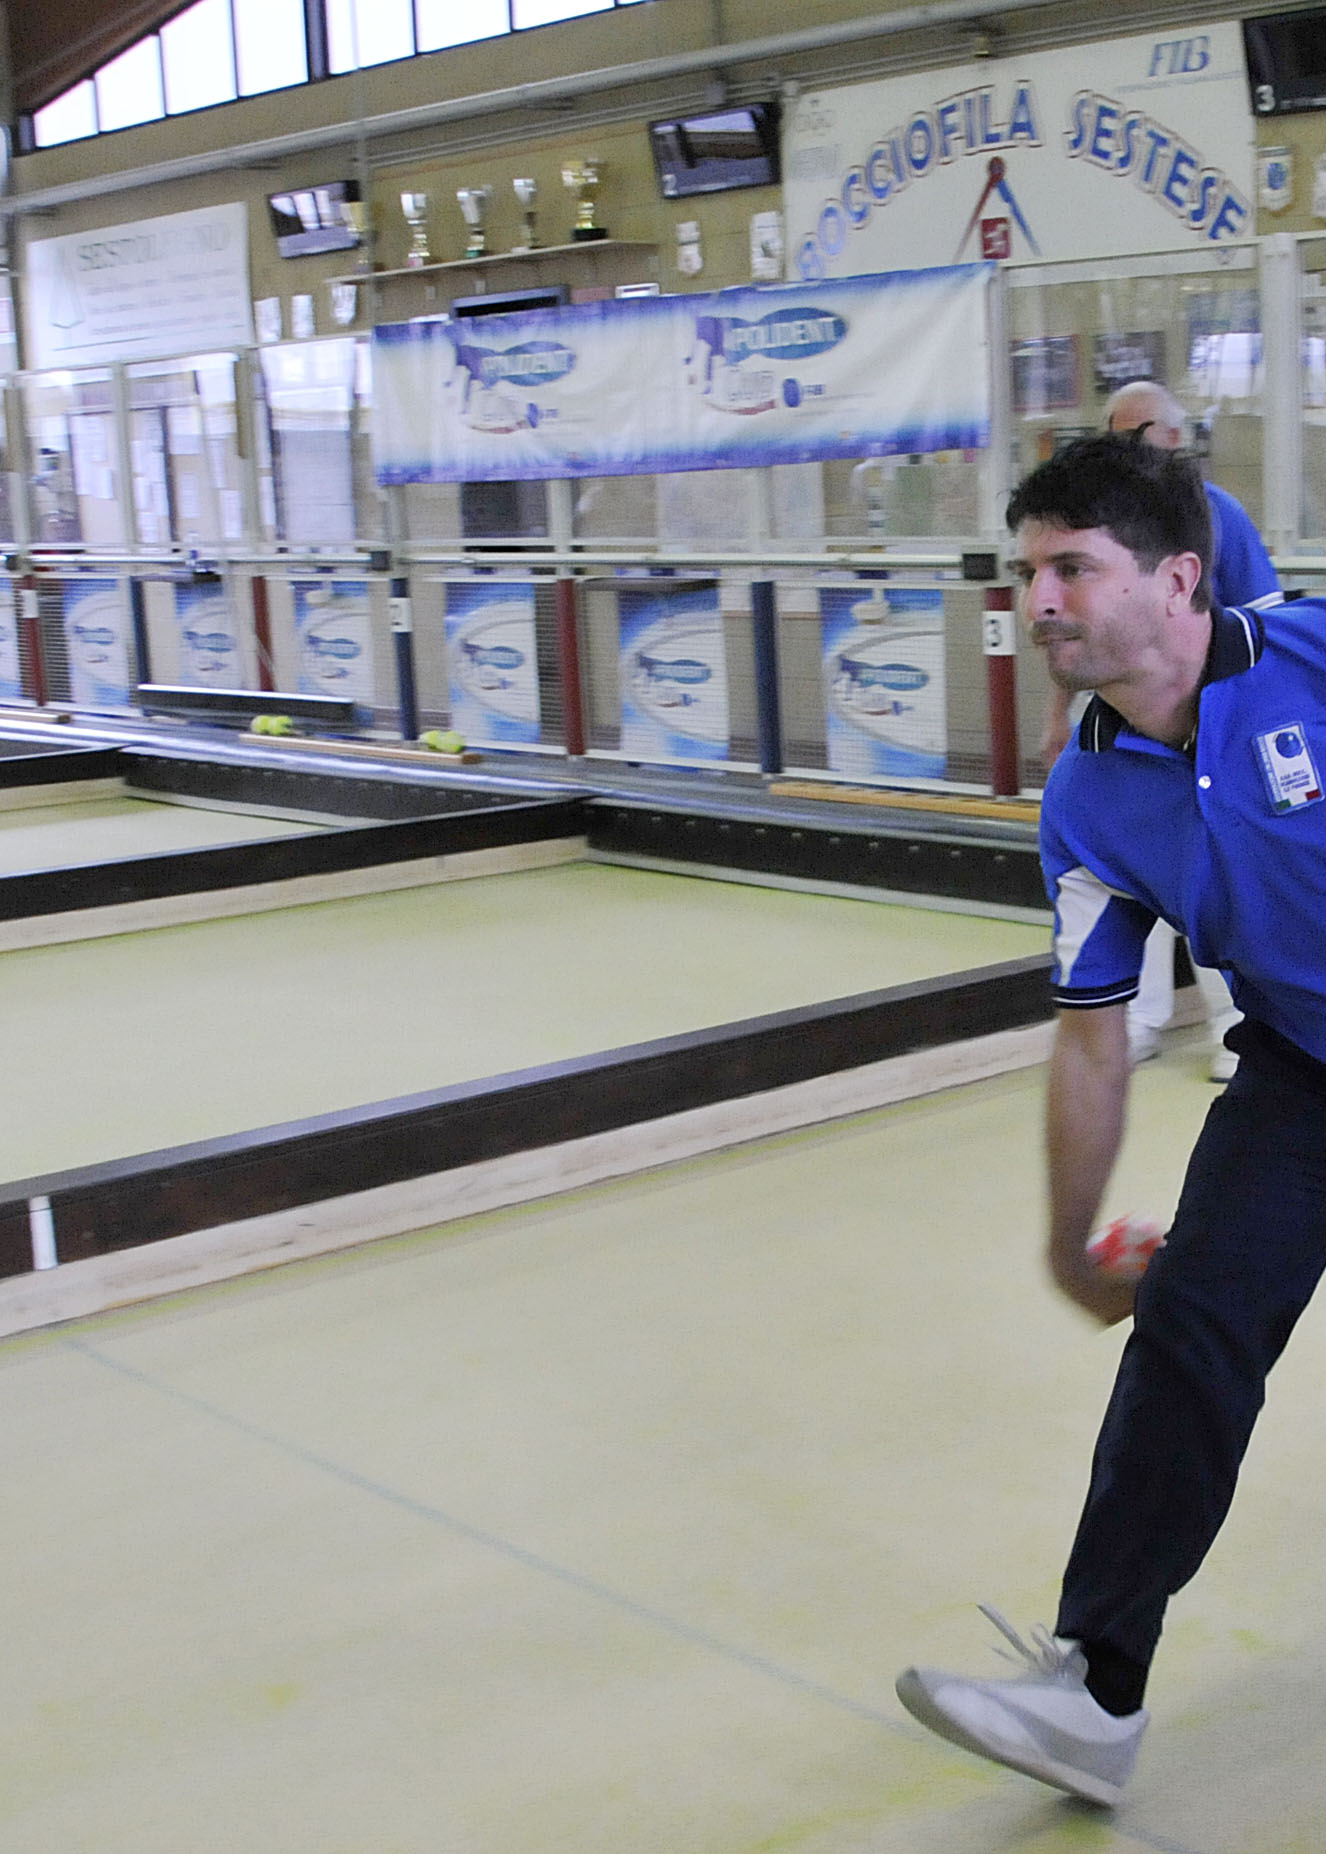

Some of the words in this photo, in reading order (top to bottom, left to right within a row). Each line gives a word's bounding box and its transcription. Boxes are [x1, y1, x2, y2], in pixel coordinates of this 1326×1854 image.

[1149, 36, 1211, 77] FIB
[1255, 84, 1276, 112] 3
[662, 173, 678, 196] 2
[796, 82, 1042, 280] BOCCIOFILA
[1067, 92, 1249, 243] SESTESE
[986, 619, 1003, 648] 3
